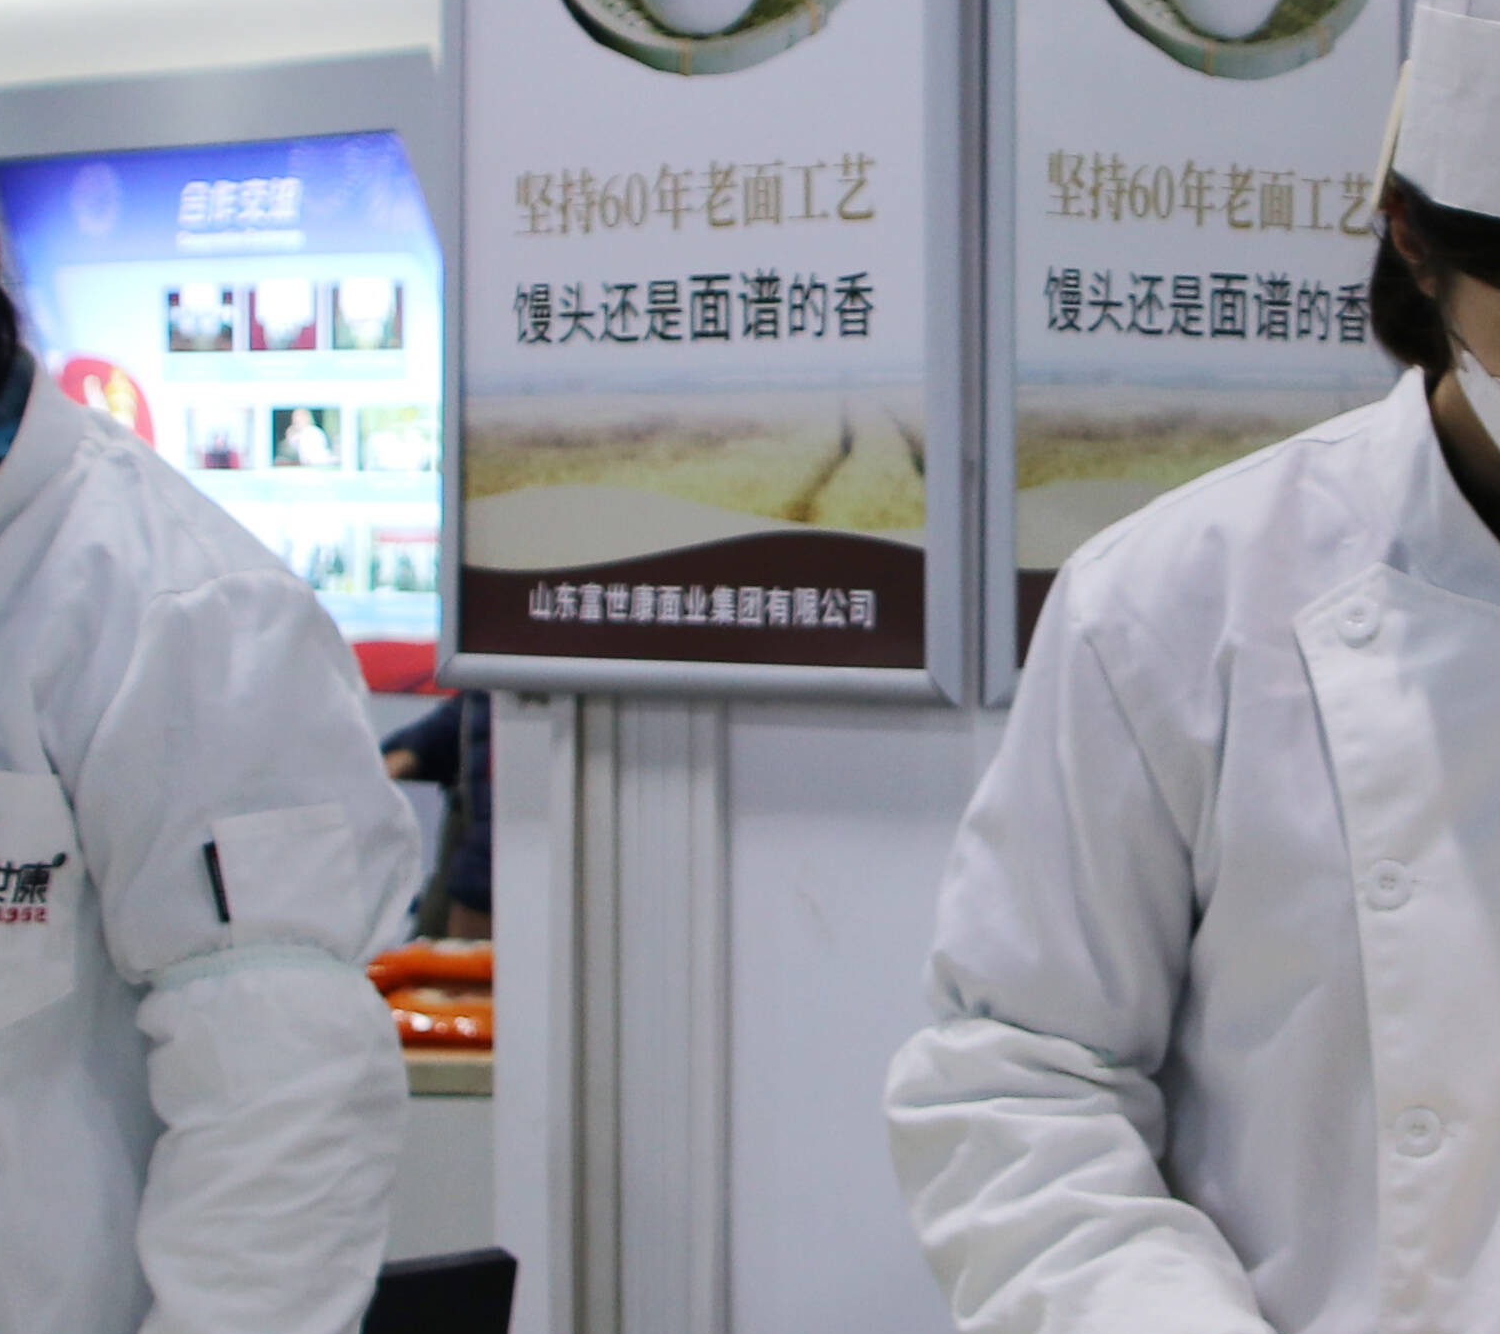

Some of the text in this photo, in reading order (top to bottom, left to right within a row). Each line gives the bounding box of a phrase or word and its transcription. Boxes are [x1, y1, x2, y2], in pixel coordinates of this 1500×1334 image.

[514, 152, 877, 236] 坚持60年老面工艺
[1046, 149, 1375, 237] 坚持60年老面工艺
[513, 267, 876, 346] 馒头还是面谱的香
[1043, 265, 1370, 345] 馒头还是面谱的香
[528, 581, 877, 629] 山东富世康面业集团有限公司
